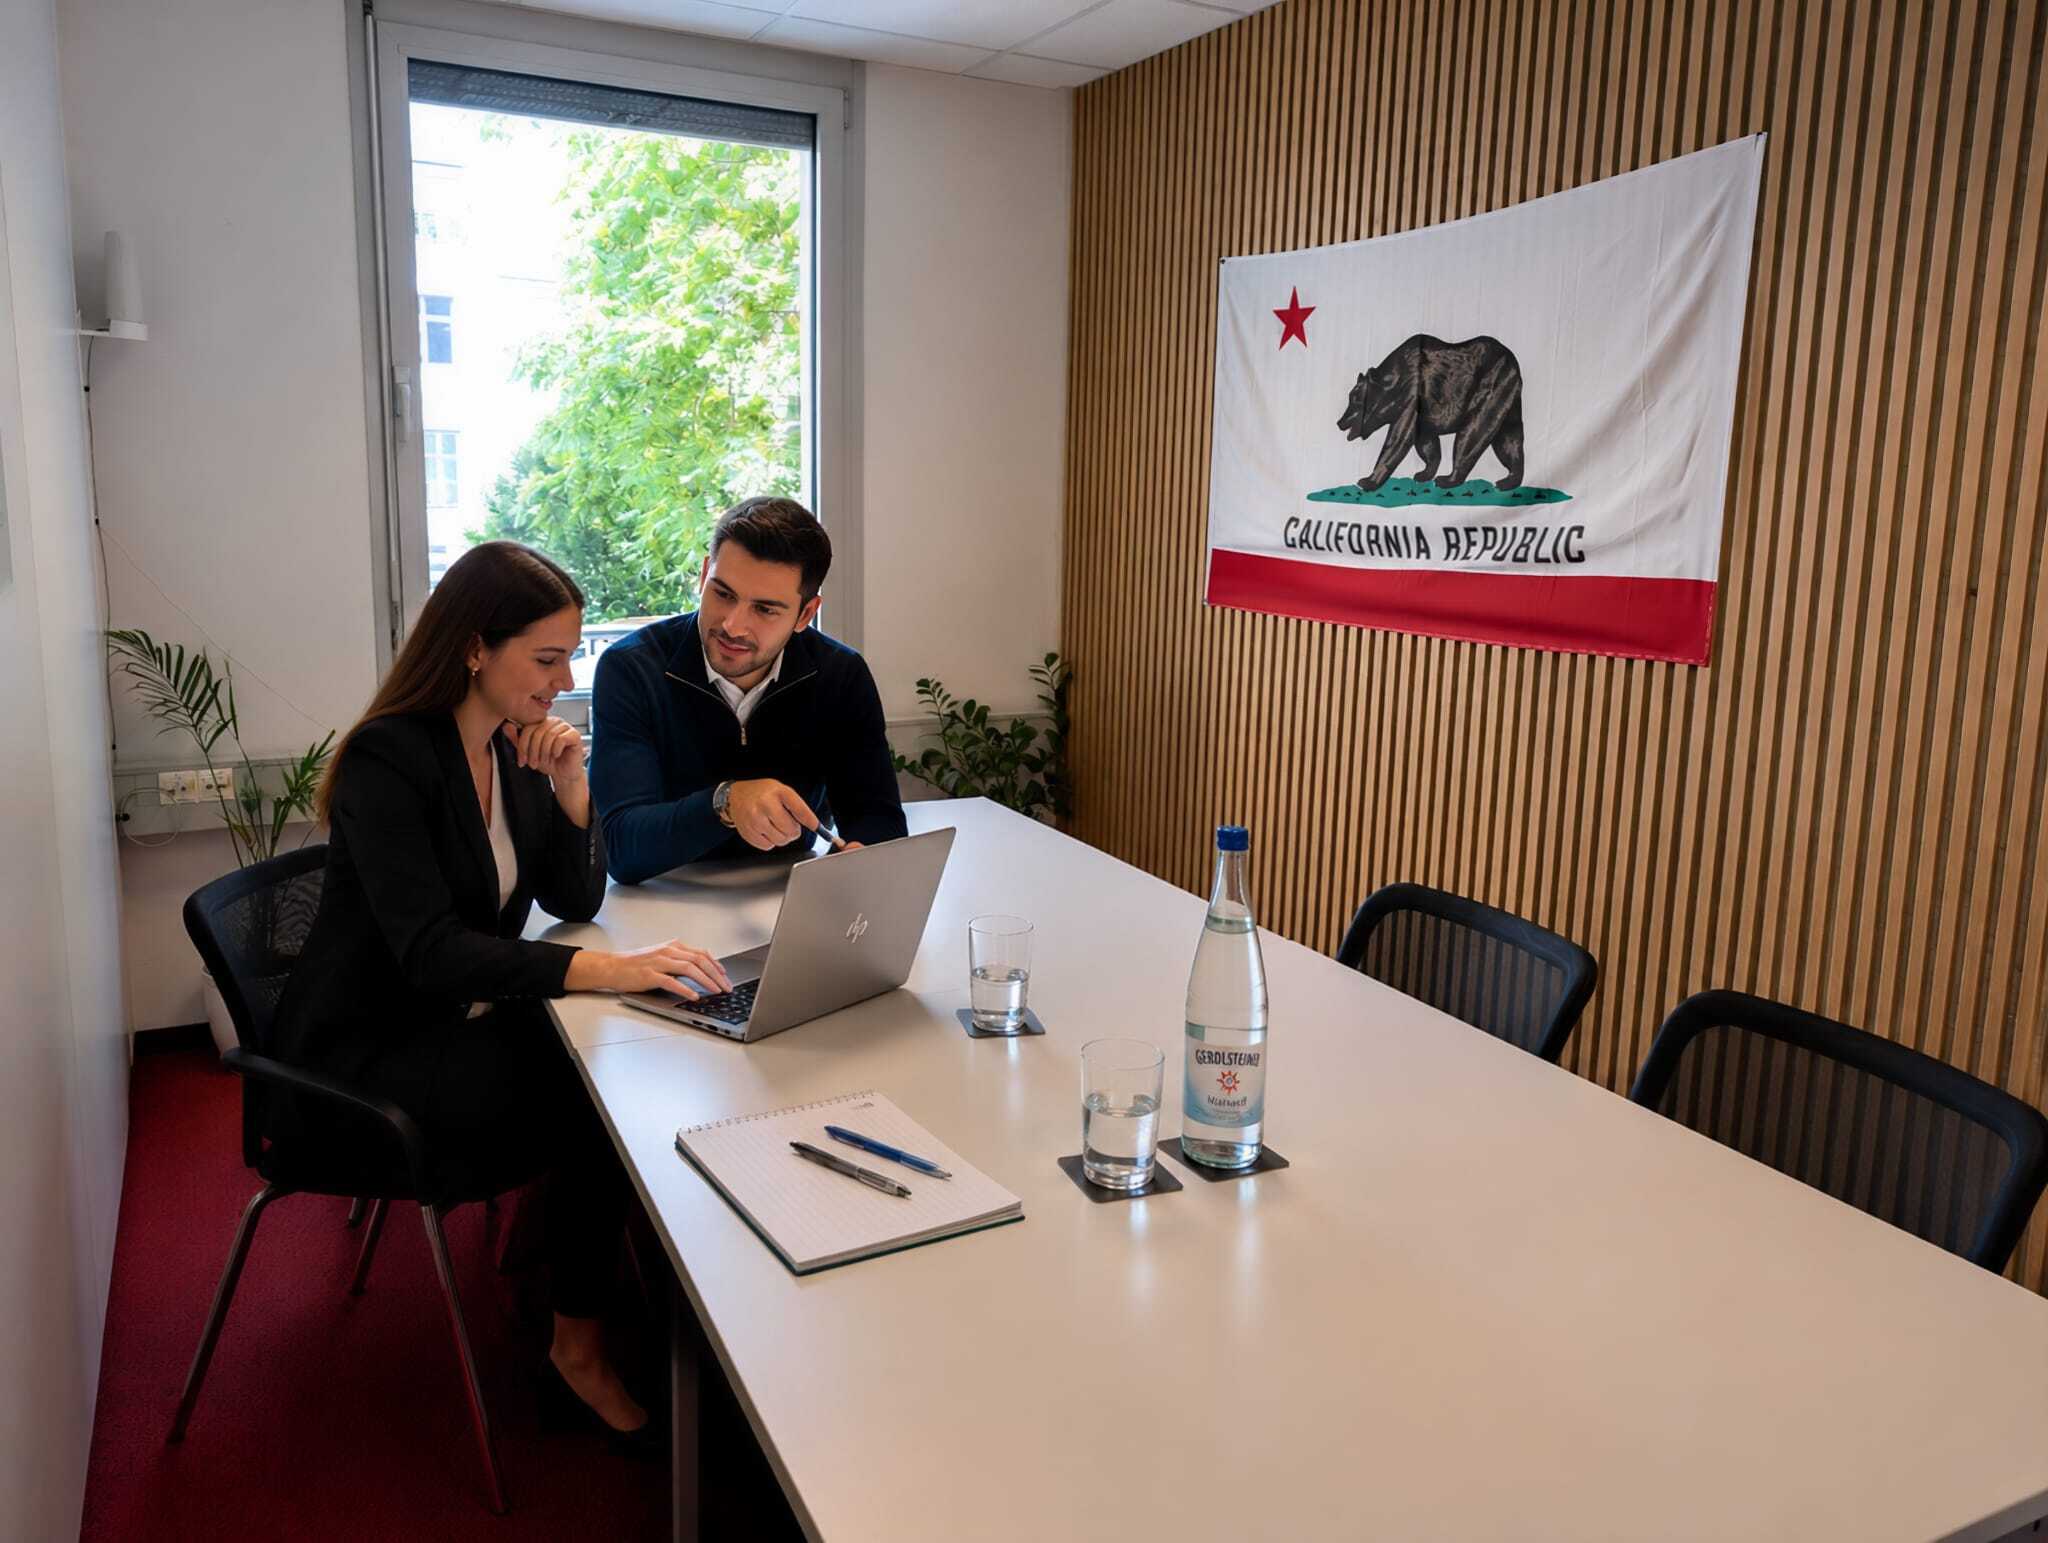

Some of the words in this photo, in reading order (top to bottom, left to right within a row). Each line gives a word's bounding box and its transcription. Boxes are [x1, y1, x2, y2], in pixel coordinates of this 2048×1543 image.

[1284, 516, 1431, 560] CALIFORNIA
[1443, 525, 1585, 563] REPUBLIC
[846, 912, 868, 944] hp
